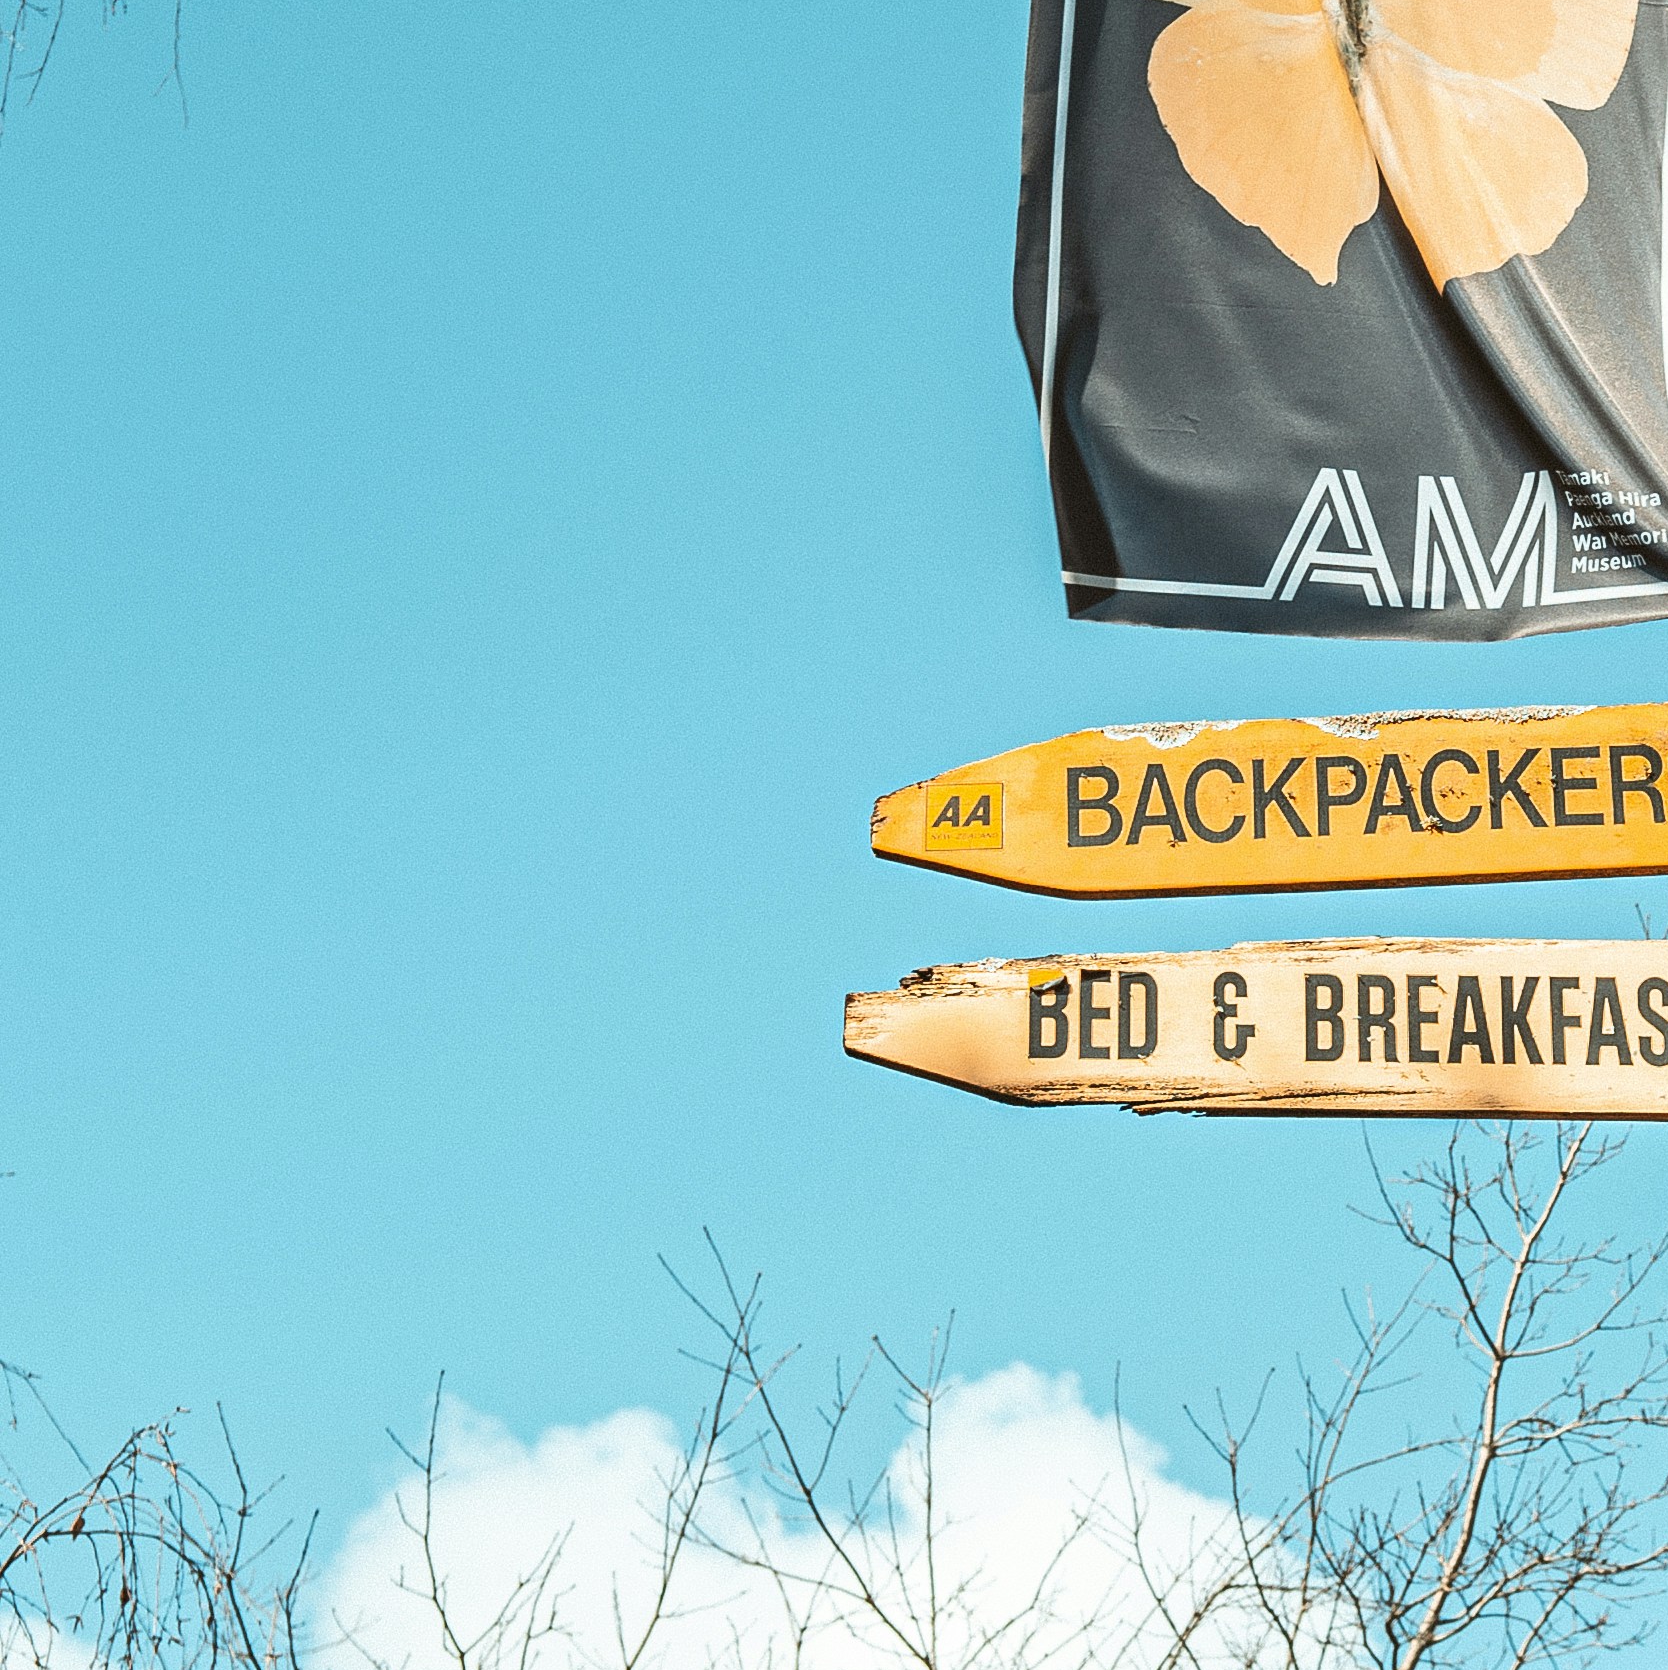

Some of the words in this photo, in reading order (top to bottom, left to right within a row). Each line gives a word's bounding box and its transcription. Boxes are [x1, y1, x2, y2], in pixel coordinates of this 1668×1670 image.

[1618, 490, 1662, 508] Hira
[1572, 508, 1636, 530] Auckland
[1264, 467, 1556, 610] AM
[1572, 533, 1607, 552] War
[1571, 553, 1647, 574] Museum
[931, 795, 991, 828] AA
[1027, 969, 1159, 1062] BED
[1213, 971, 1257, 1064] &
